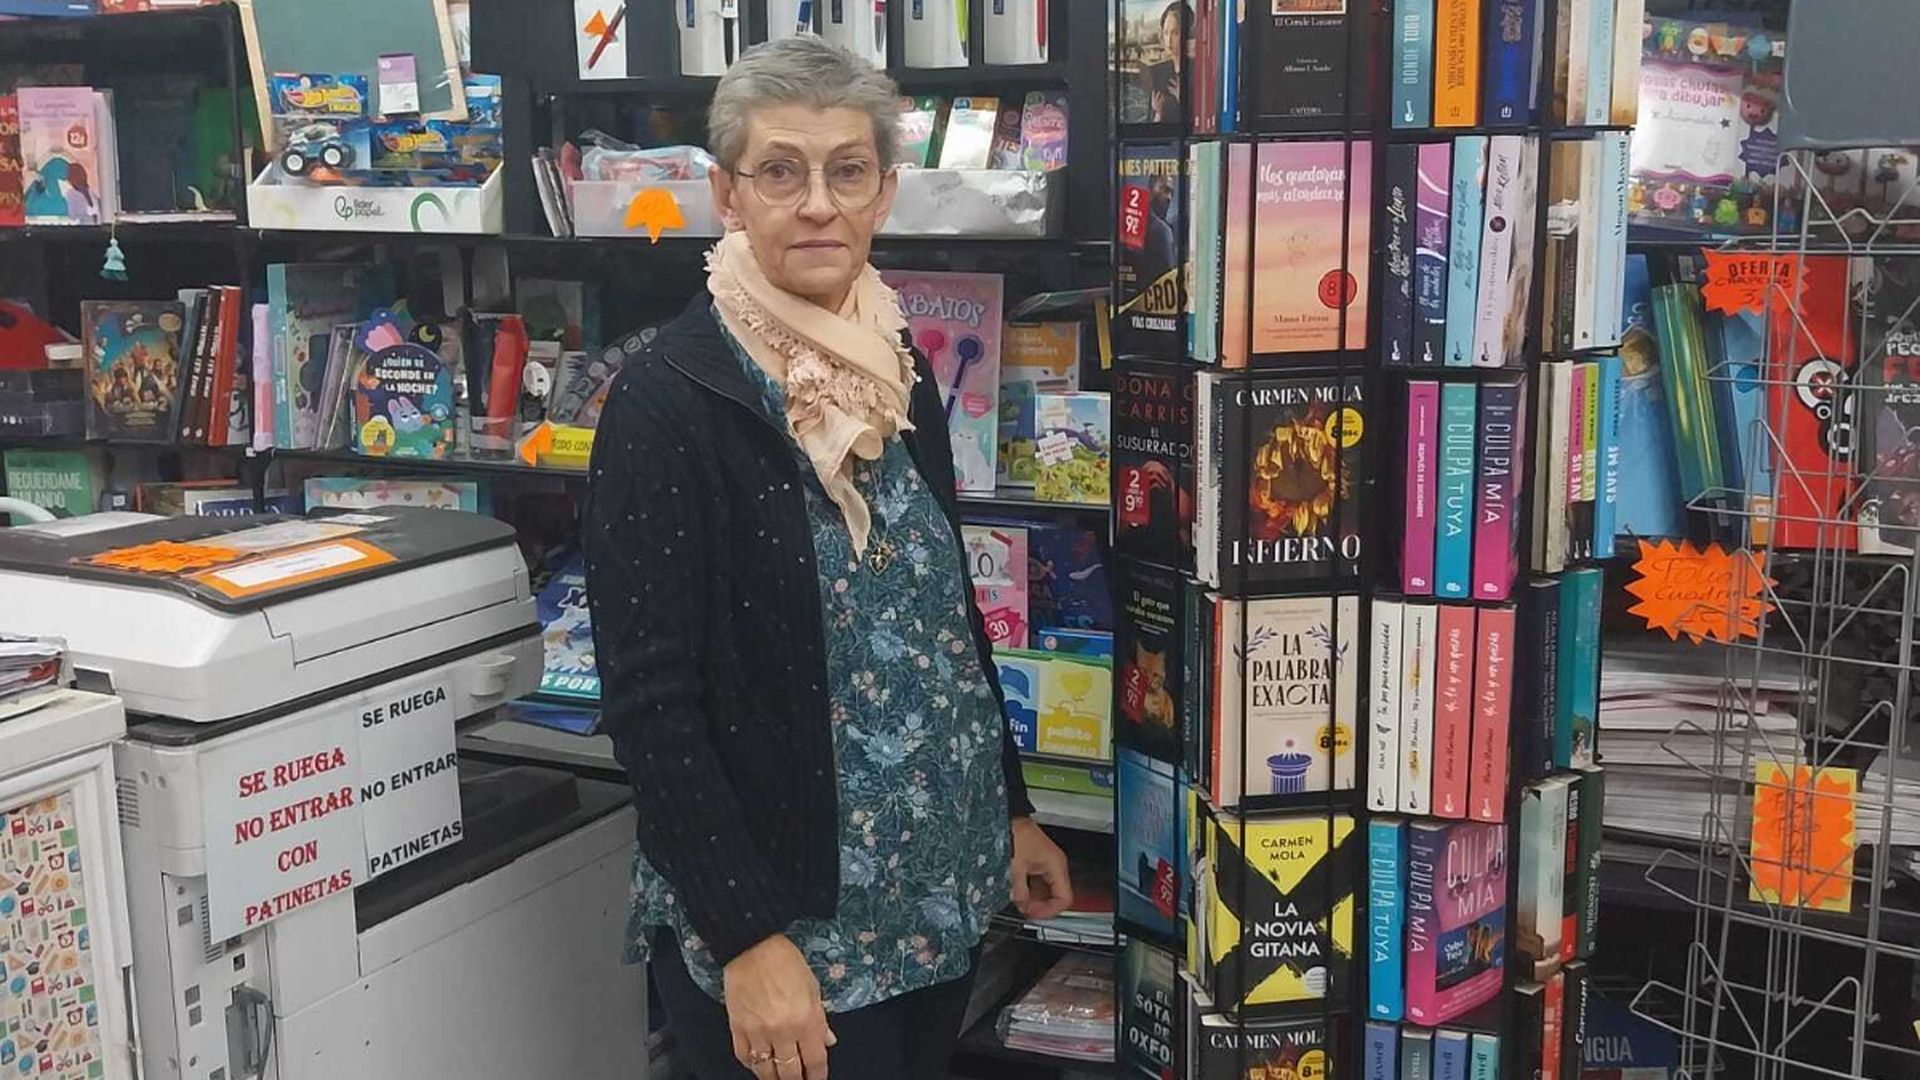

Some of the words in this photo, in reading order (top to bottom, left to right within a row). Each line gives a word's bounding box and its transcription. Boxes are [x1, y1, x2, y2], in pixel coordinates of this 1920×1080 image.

[1404, 14, 1420, 43] TODO
[1402, 54, 1419, 85] DONDE
[1260, 163, 1284, 186] Nos
[1283, 187, 1345, 203] atardecere
[1728, 261, 1790, 278] OFERTA
[375, 367, 422, 381] ESCONDE
[385, 382, 397, 392] LA
[397, 382, 439, 396] NOCHE?
[1235, 388, 1310, 408] CARMEN
[1314, 384, 1364, 404] MOLA
[1150, 426, 1160, 438] EL
[1446, 424, 1473, 477] CULPA
[1484, 423, 1512, 477] CULPA
[1607, 445, 1620, 466] ME
[1605, 470, 1618, 503] SAVE
[1446, 483, 1465, 538] TUYA
[1484, 483, 1505, 525] MÍA
[989, 619, 1010, 640] 30
[1283, 634, 1302, 656] LA
[1378, 623, 1391, 669] casualidad
[554, 675, 598, 692] POR
[1252, 658, 1332, 682] PALABRA
[362, 707, 384, 729] SE
[389, 686, 447, 720] RUEGA
[1252, 683, 1331, 707] EXACTA
[238, 771, 268, 798] SE
[272, 747, 347, 789] RUEGA
[360, 780, 386, 804] NO
[390, 752, 459, 792] ENTRAR
[234, 816, 265, 845] NO
[269, 786, 354, 834] ENTRAR
[277, 839, 319, 873] CON
[370, 820, 463, 875] PATINETAS
[1260, 835, 1314, 849] CARMEN
[1269, 850, 1306, 861] MOLA
[1446, 828, 1504, 889] CULPA
[1372, 853, 1397, 909] CULPA
[1410, 858, 1434, 915] CULPA
[245, 869, 353, 926] PATINETAS
[1274, 901, 1299, 917] LA
[1457, 884, 1495, 918] MÍA
[1254, 921, 1318, 937] NOVIA
[1373, 911, 1391, 964] TUYA
[1410, 917, 1429, 954] MÍA
[1250, 941, 1321, 959] GITANA
[1135, 993, 1172, 1026] SOTA
[1129, 1026, 1175, 1064] OXFO
[1154, 1022, 1170, 1038] DE
